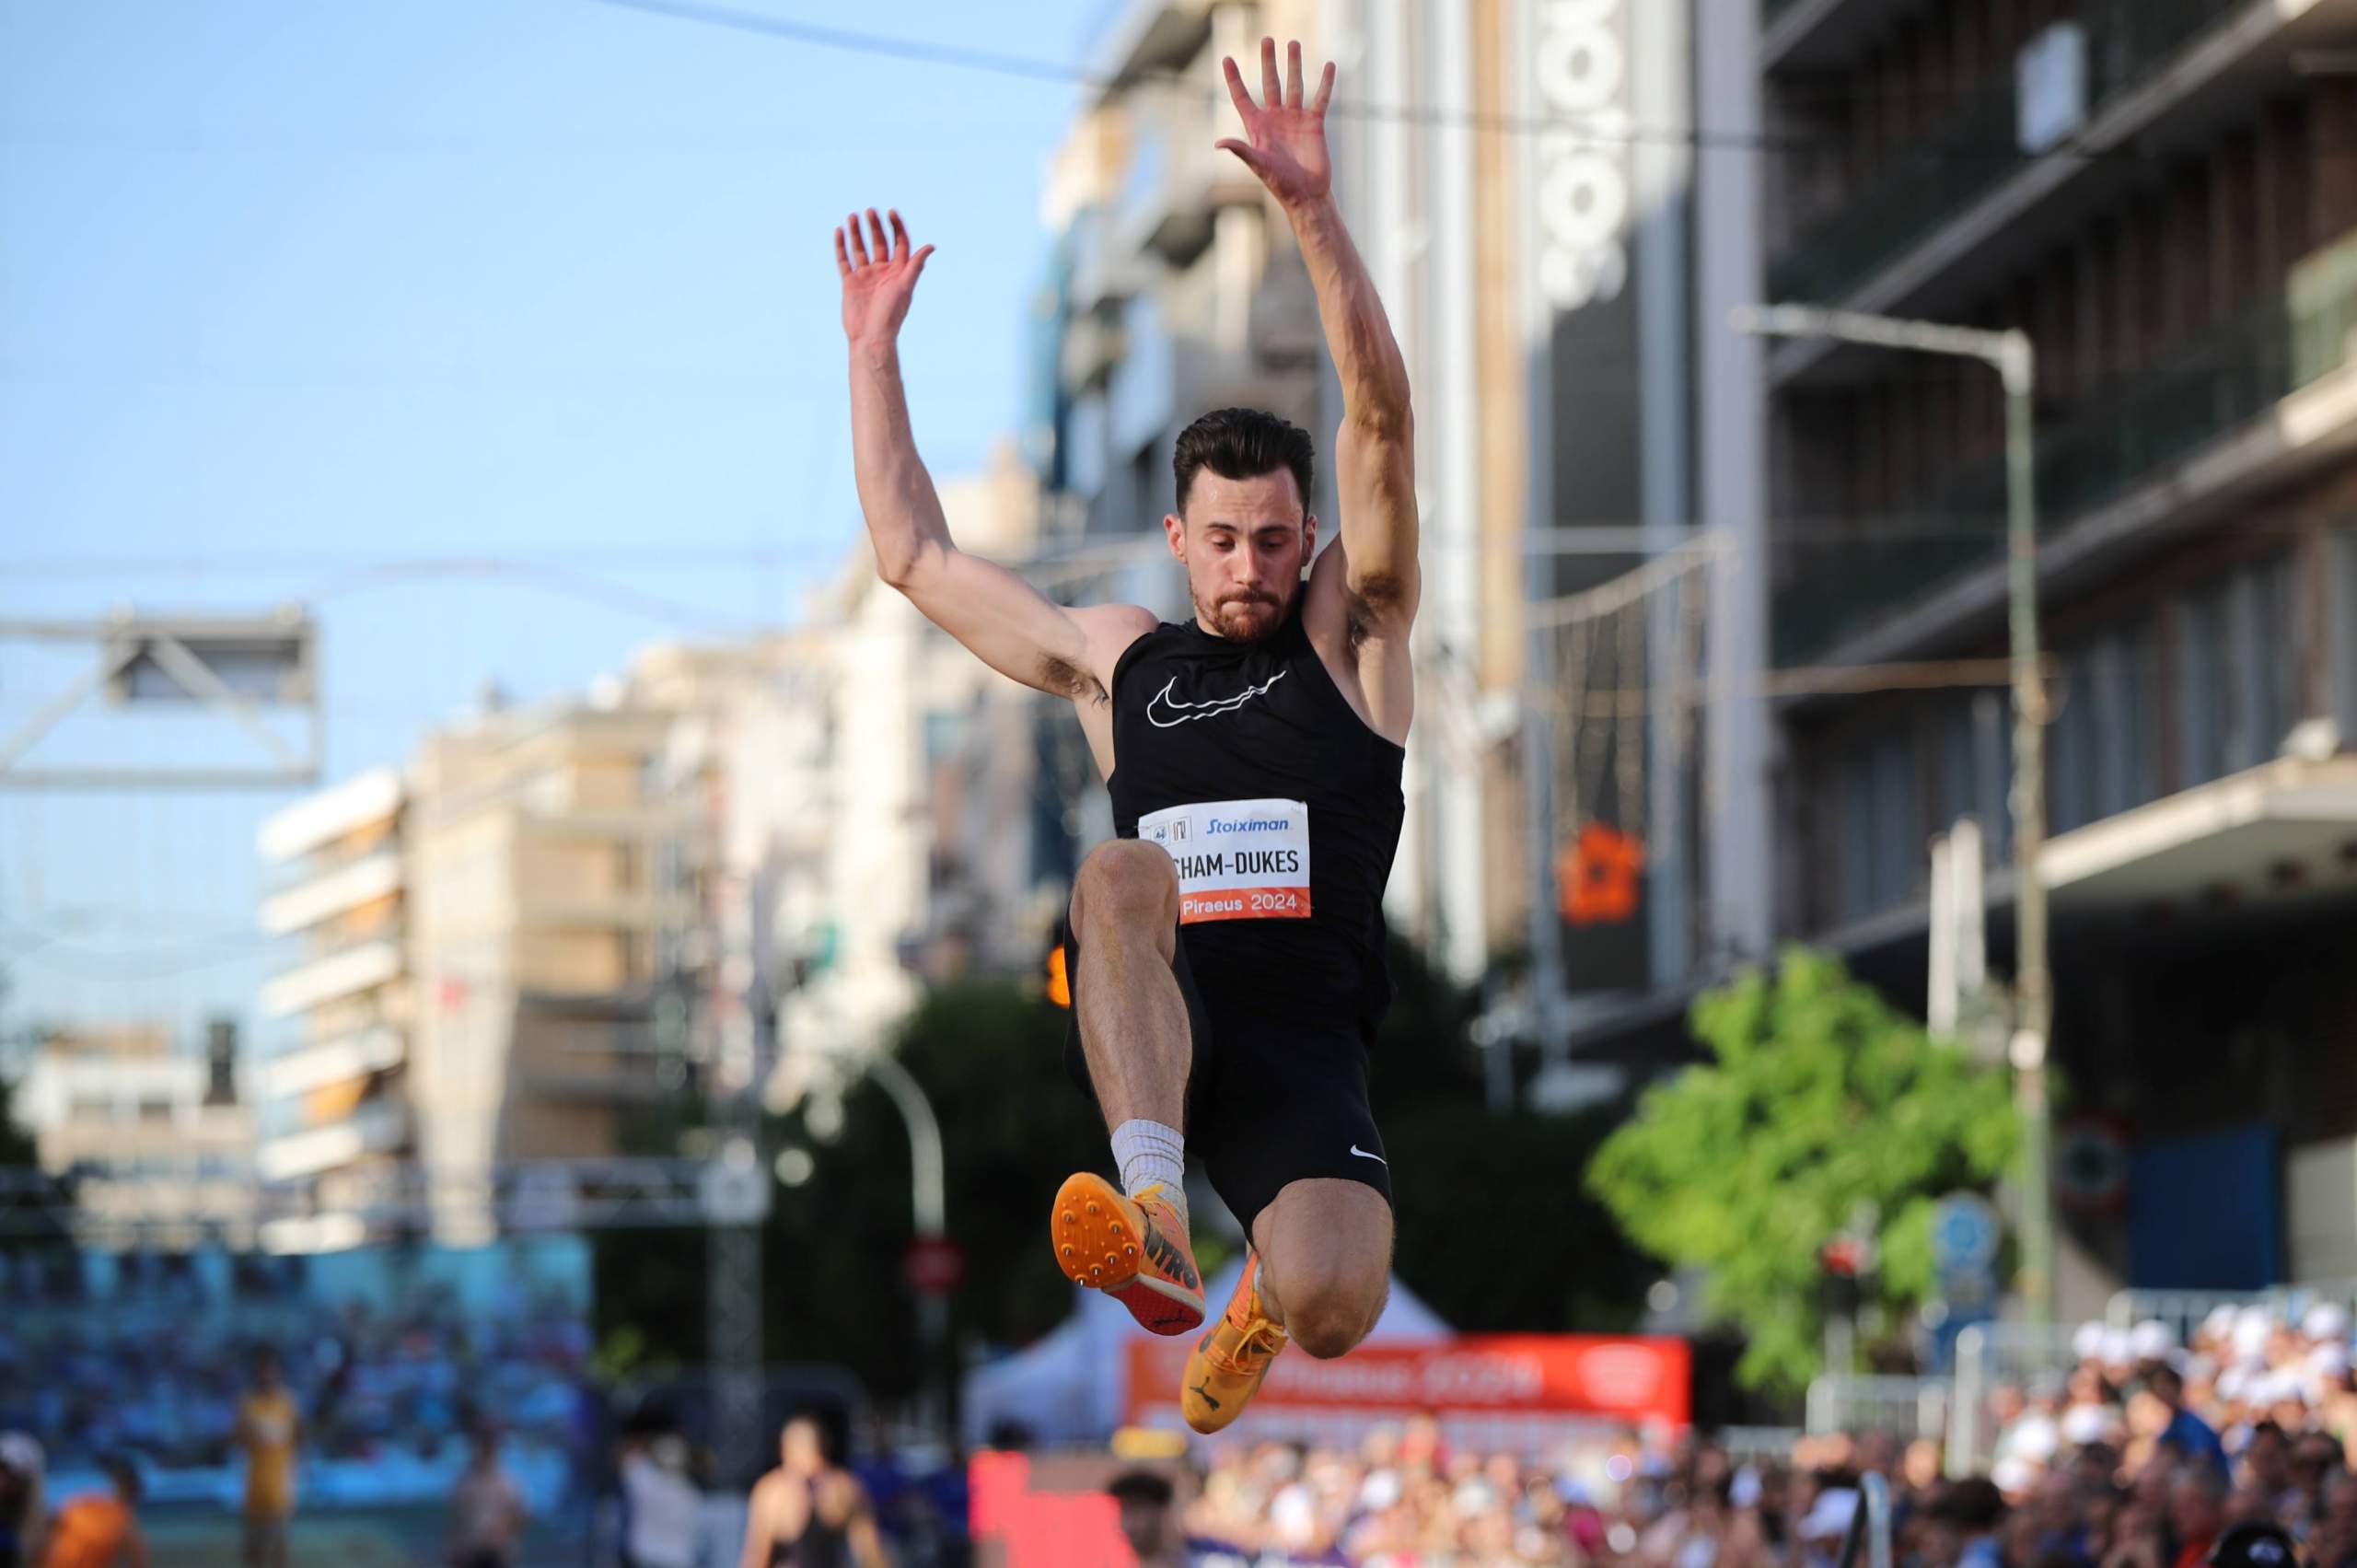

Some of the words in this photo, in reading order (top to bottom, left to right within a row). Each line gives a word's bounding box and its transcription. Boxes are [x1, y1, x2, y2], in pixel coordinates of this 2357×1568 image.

[1206, 818, 1289, 835] Stoiximan
[1182, 899, 1243, 916] Piraeus
[1251, 893, 1297, 911] 2024
